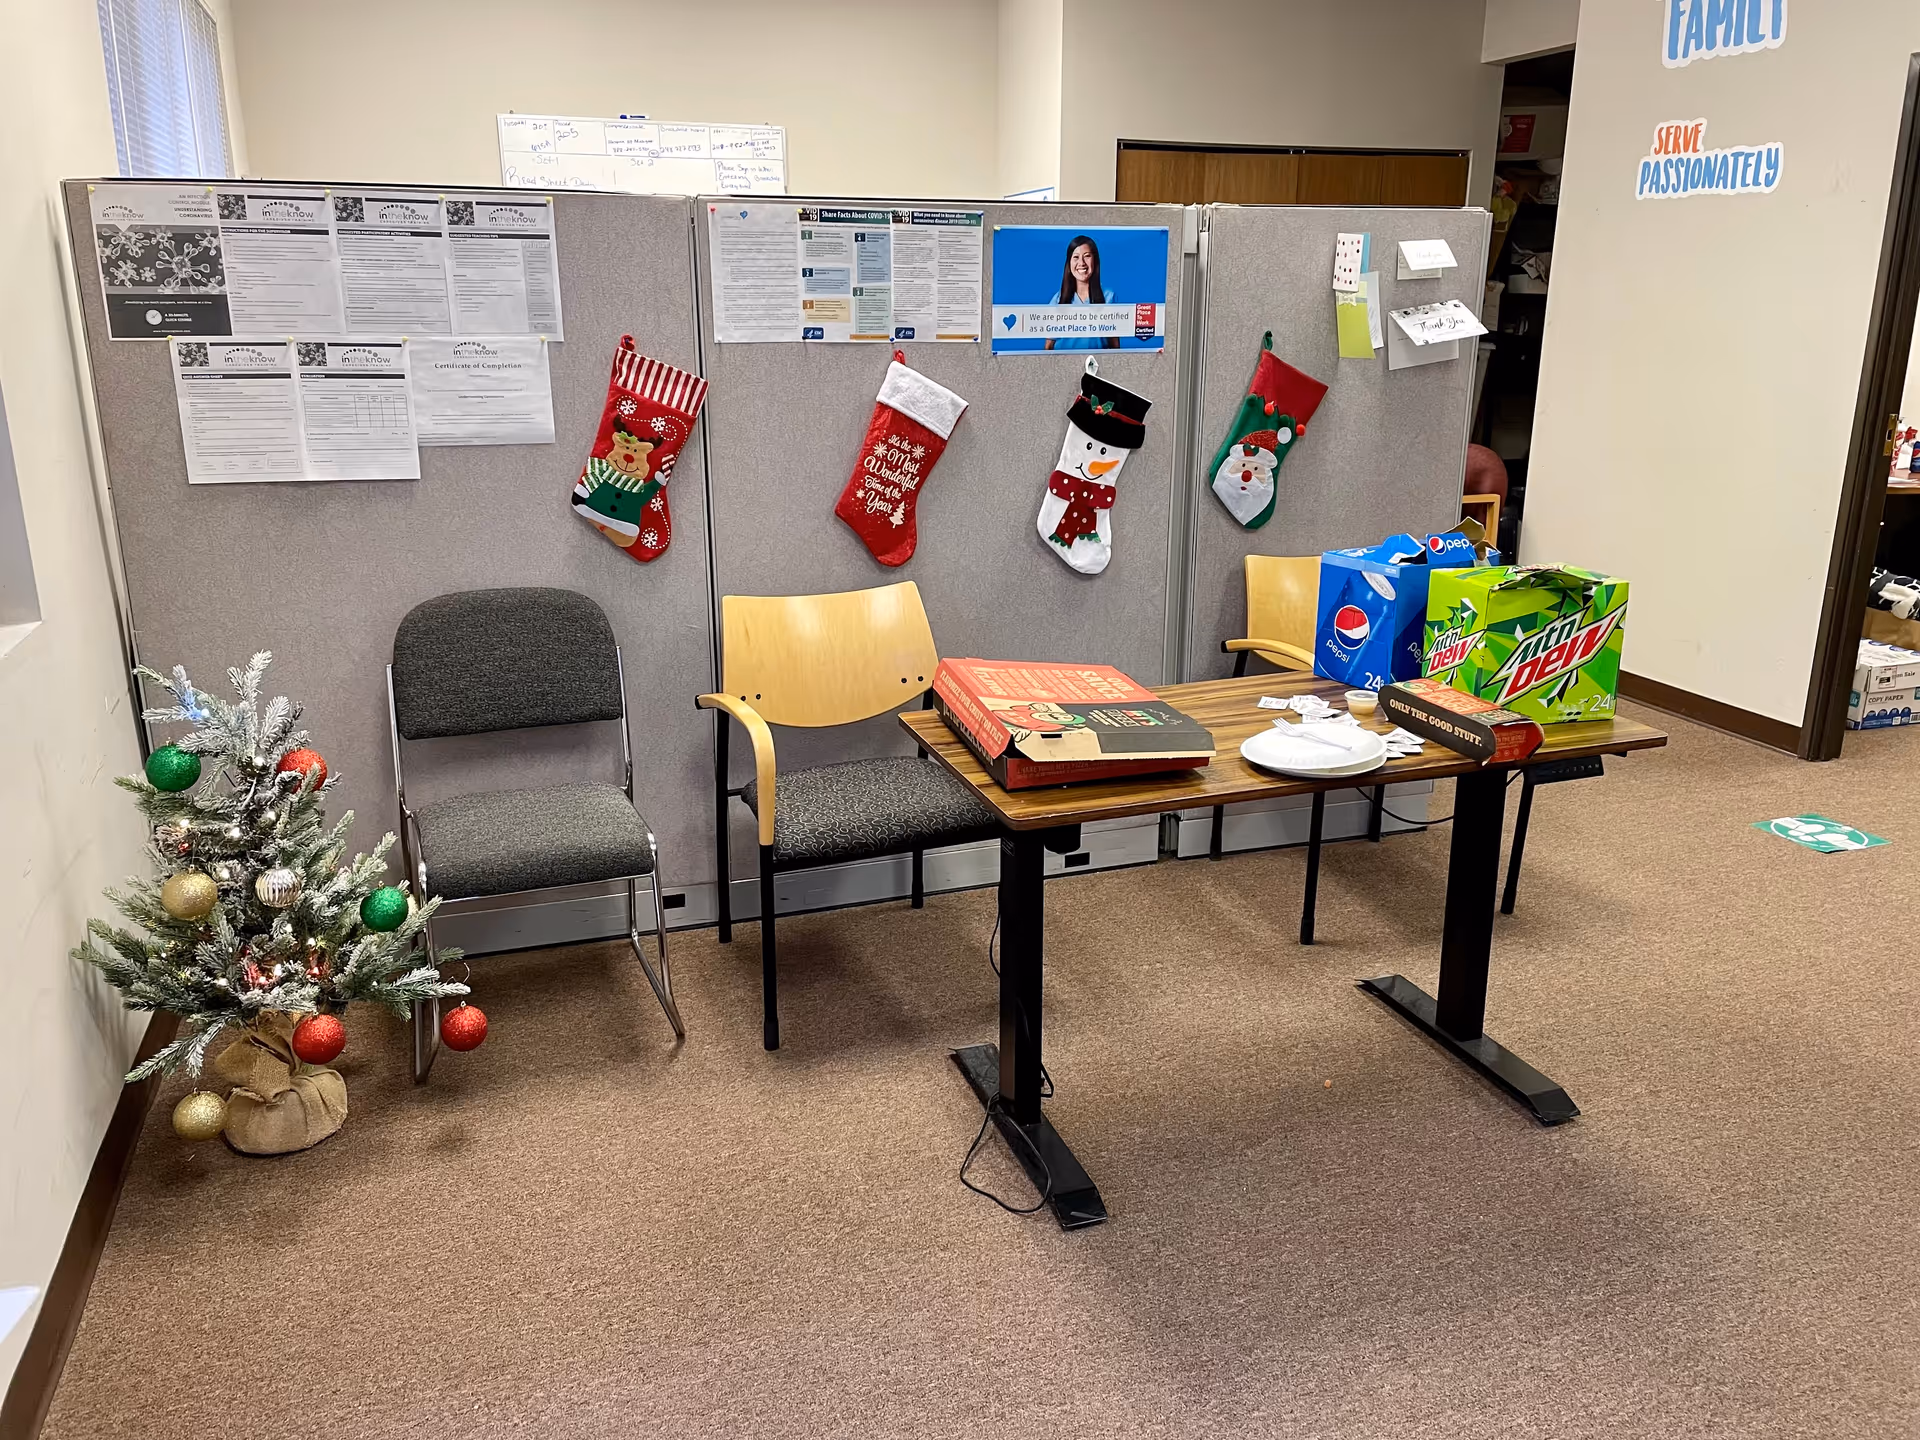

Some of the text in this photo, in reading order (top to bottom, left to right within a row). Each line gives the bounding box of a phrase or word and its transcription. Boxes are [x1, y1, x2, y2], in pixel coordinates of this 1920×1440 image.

[1654, 122, 1703, 155] SERVE
[1639, 147, 1779, 195] PASSIONATELY
[262, 208, 314, 218] intheknow
[379, 211, 429, 220] intheknow
[488, 214, 536, 224] intheknow
[822, 210, 836, 218] Share
[1030, 313, 1041, 321] We
[1056, 313, 1078, 322] proud
[1099, 312, 1129, 320] certified
[1413, 316, 1466, 332] Thank You
[1098, 324, 1117, 332] Work
[224, 355, 276, 363] intheknow
[341, 356, 391, 364] intheknow
[901, 440, 912, 452] the
[888, 448, 920, 474] Most
[864, 456, 920, 492] Wonderful
[864, 475, 902, 500] Time of the
[866, 491, 893, 514] Year
[1446, 538, 1472, 551] pep
[1326, 639, 1350, 663] pepsi
[1077, 670, 1123, 699] SAUCE
[1106, 677, 1137, 692] OUR
[1364, 672, 1381, 691] 24
[1590, 693, 1611, 712] 24
[1885, 694, 1904, 702] PAPER
[1390, 698, 1410, 714] ONLY
[1411, 708, 1427, 722] THE
[1428, 715, 1453, 733] GOOD
[1454, 726, 1482, 747] STUFF.
